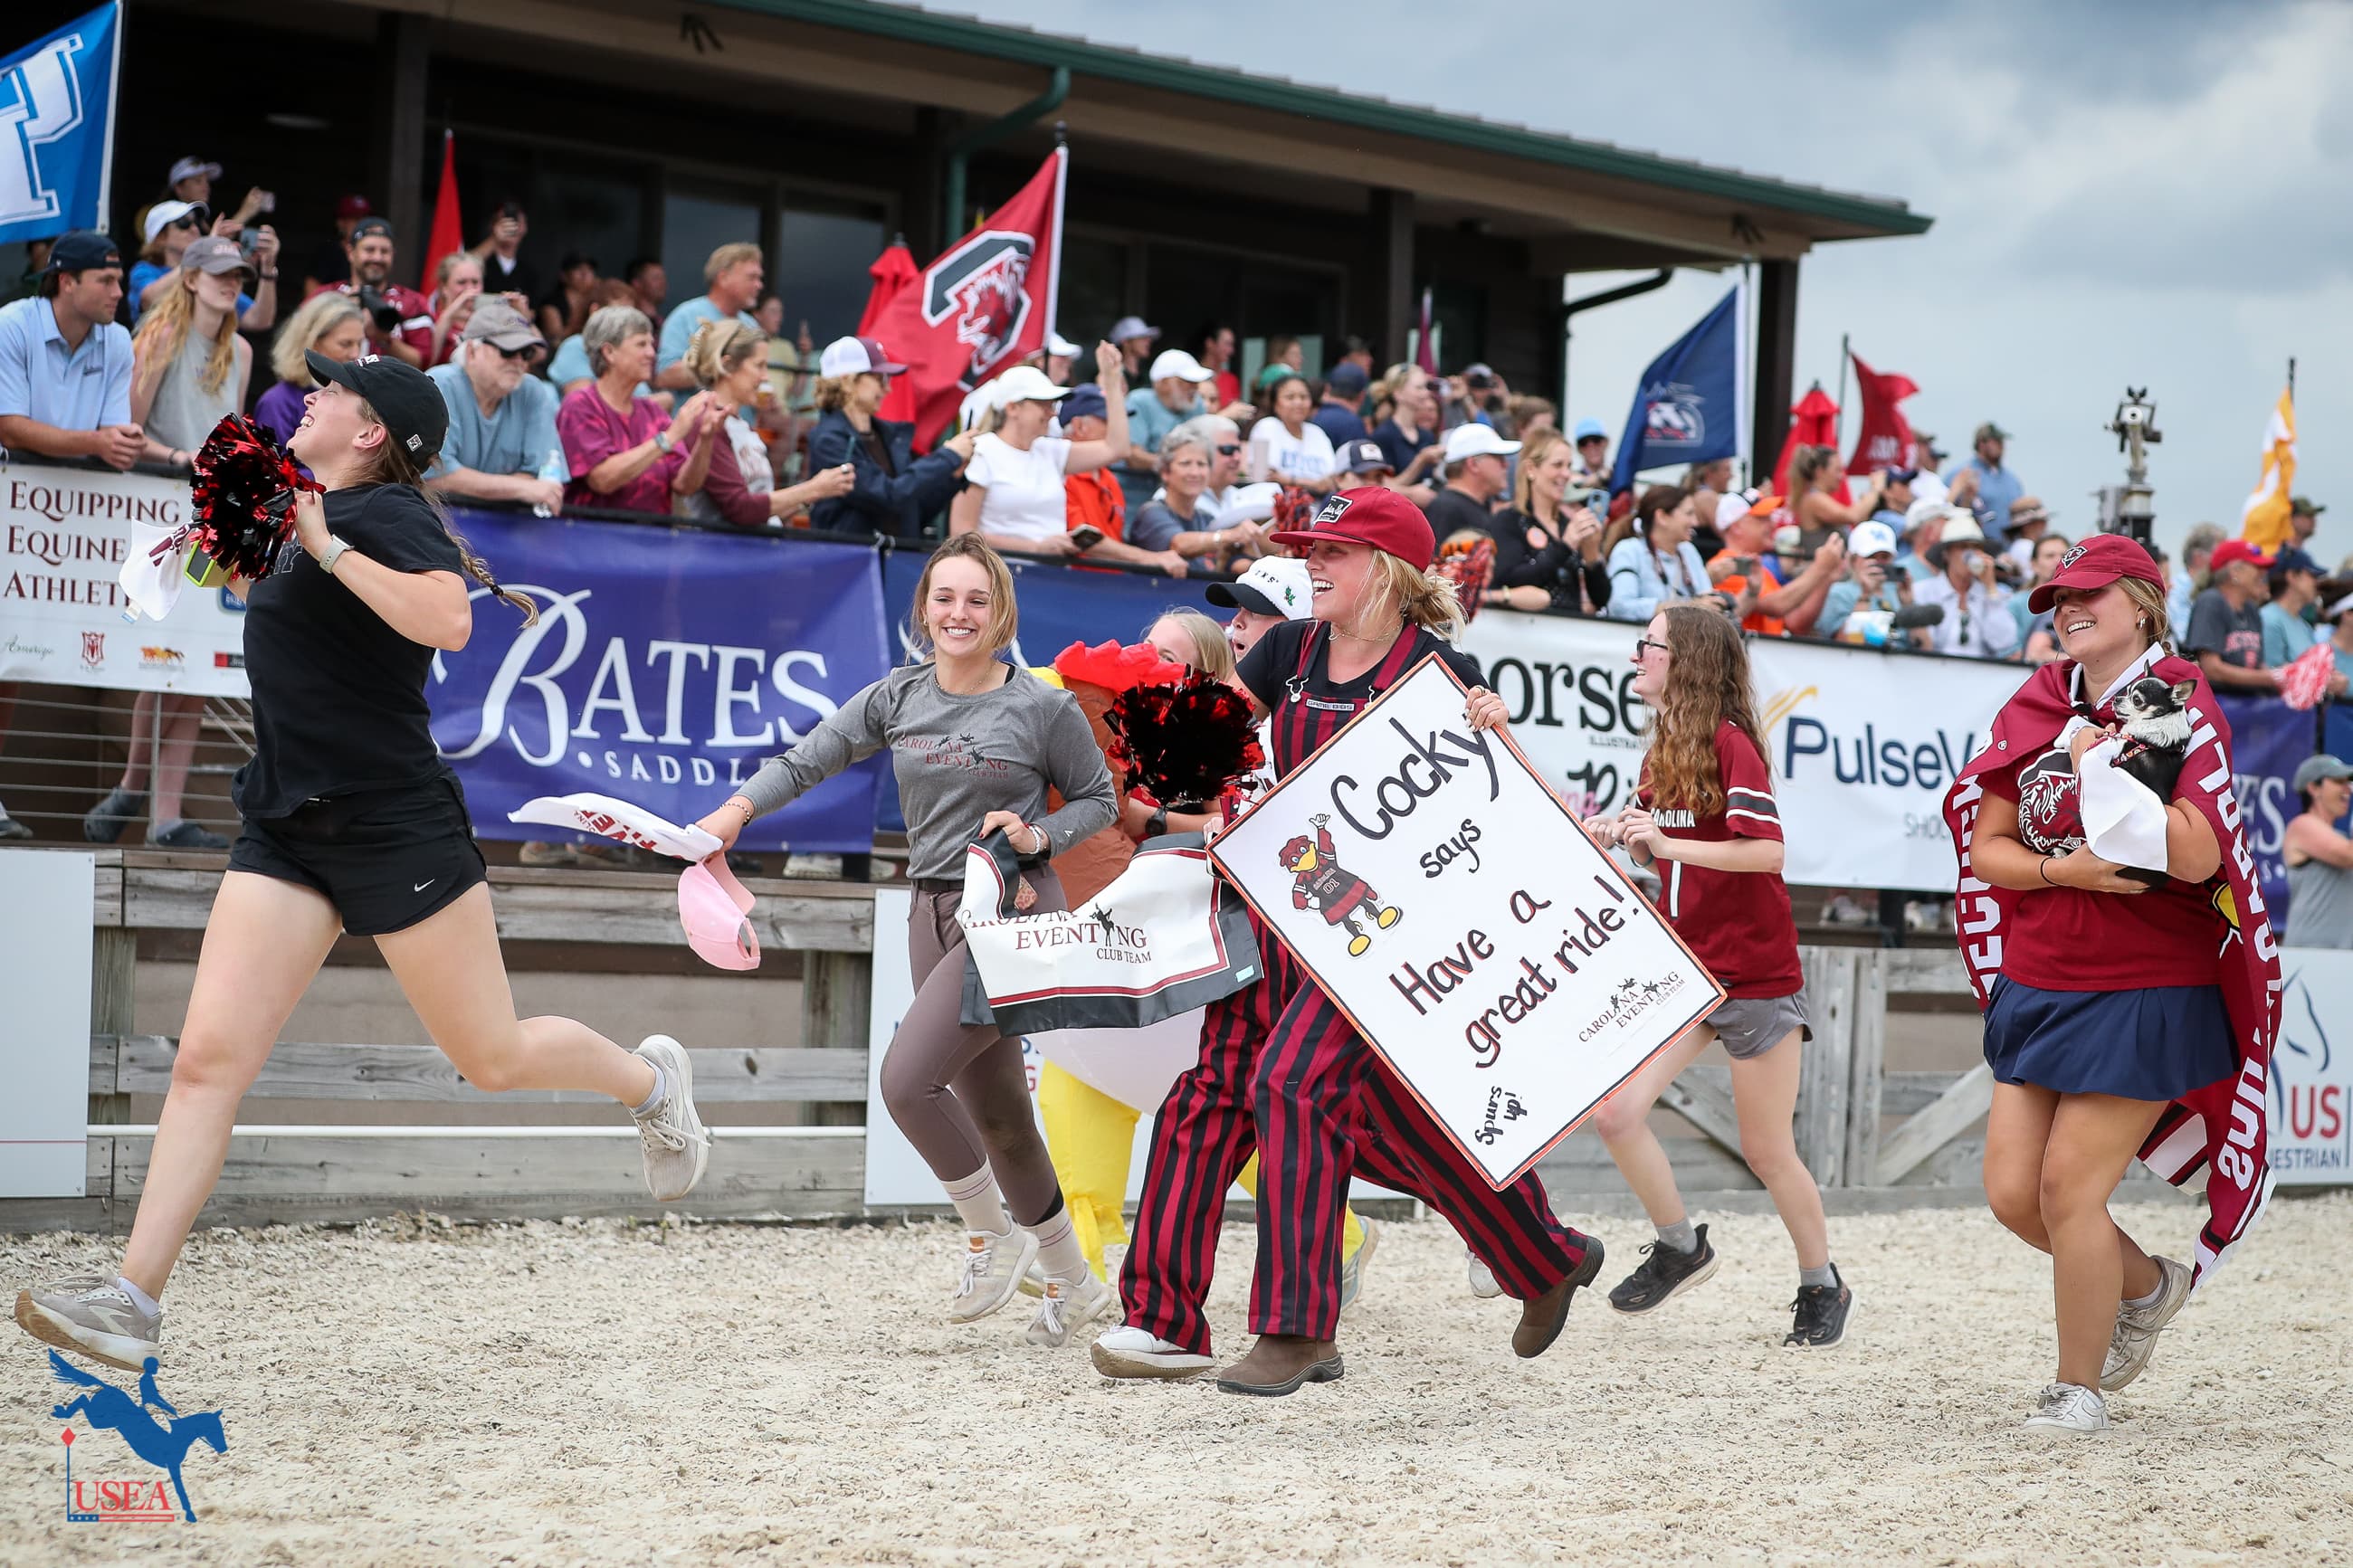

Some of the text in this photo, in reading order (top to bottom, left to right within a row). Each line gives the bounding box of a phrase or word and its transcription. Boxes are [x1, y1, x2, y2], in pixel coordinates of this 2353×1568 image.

[10, 480, 180, 524] EQUIPPING
[7, 525, 126, 566] EQUINE
[429, 583, 840, 767] BATES
[1473, 653, 1645, 737] orse
[1329, 716, 1499, 841] Cocky
[1419, 818, 1481, 879] says
[1096, 946, 1153, 965] CLUB TEAM
[1388, 889, 1553, 1016] Have a
[1464, 955, 1559, 1069] great
[1553, 874, 1641, 975] ride!
[1473, 1085, 1529, 1146] Spurs up!
[2291, 1083, 2342, 1140] US
